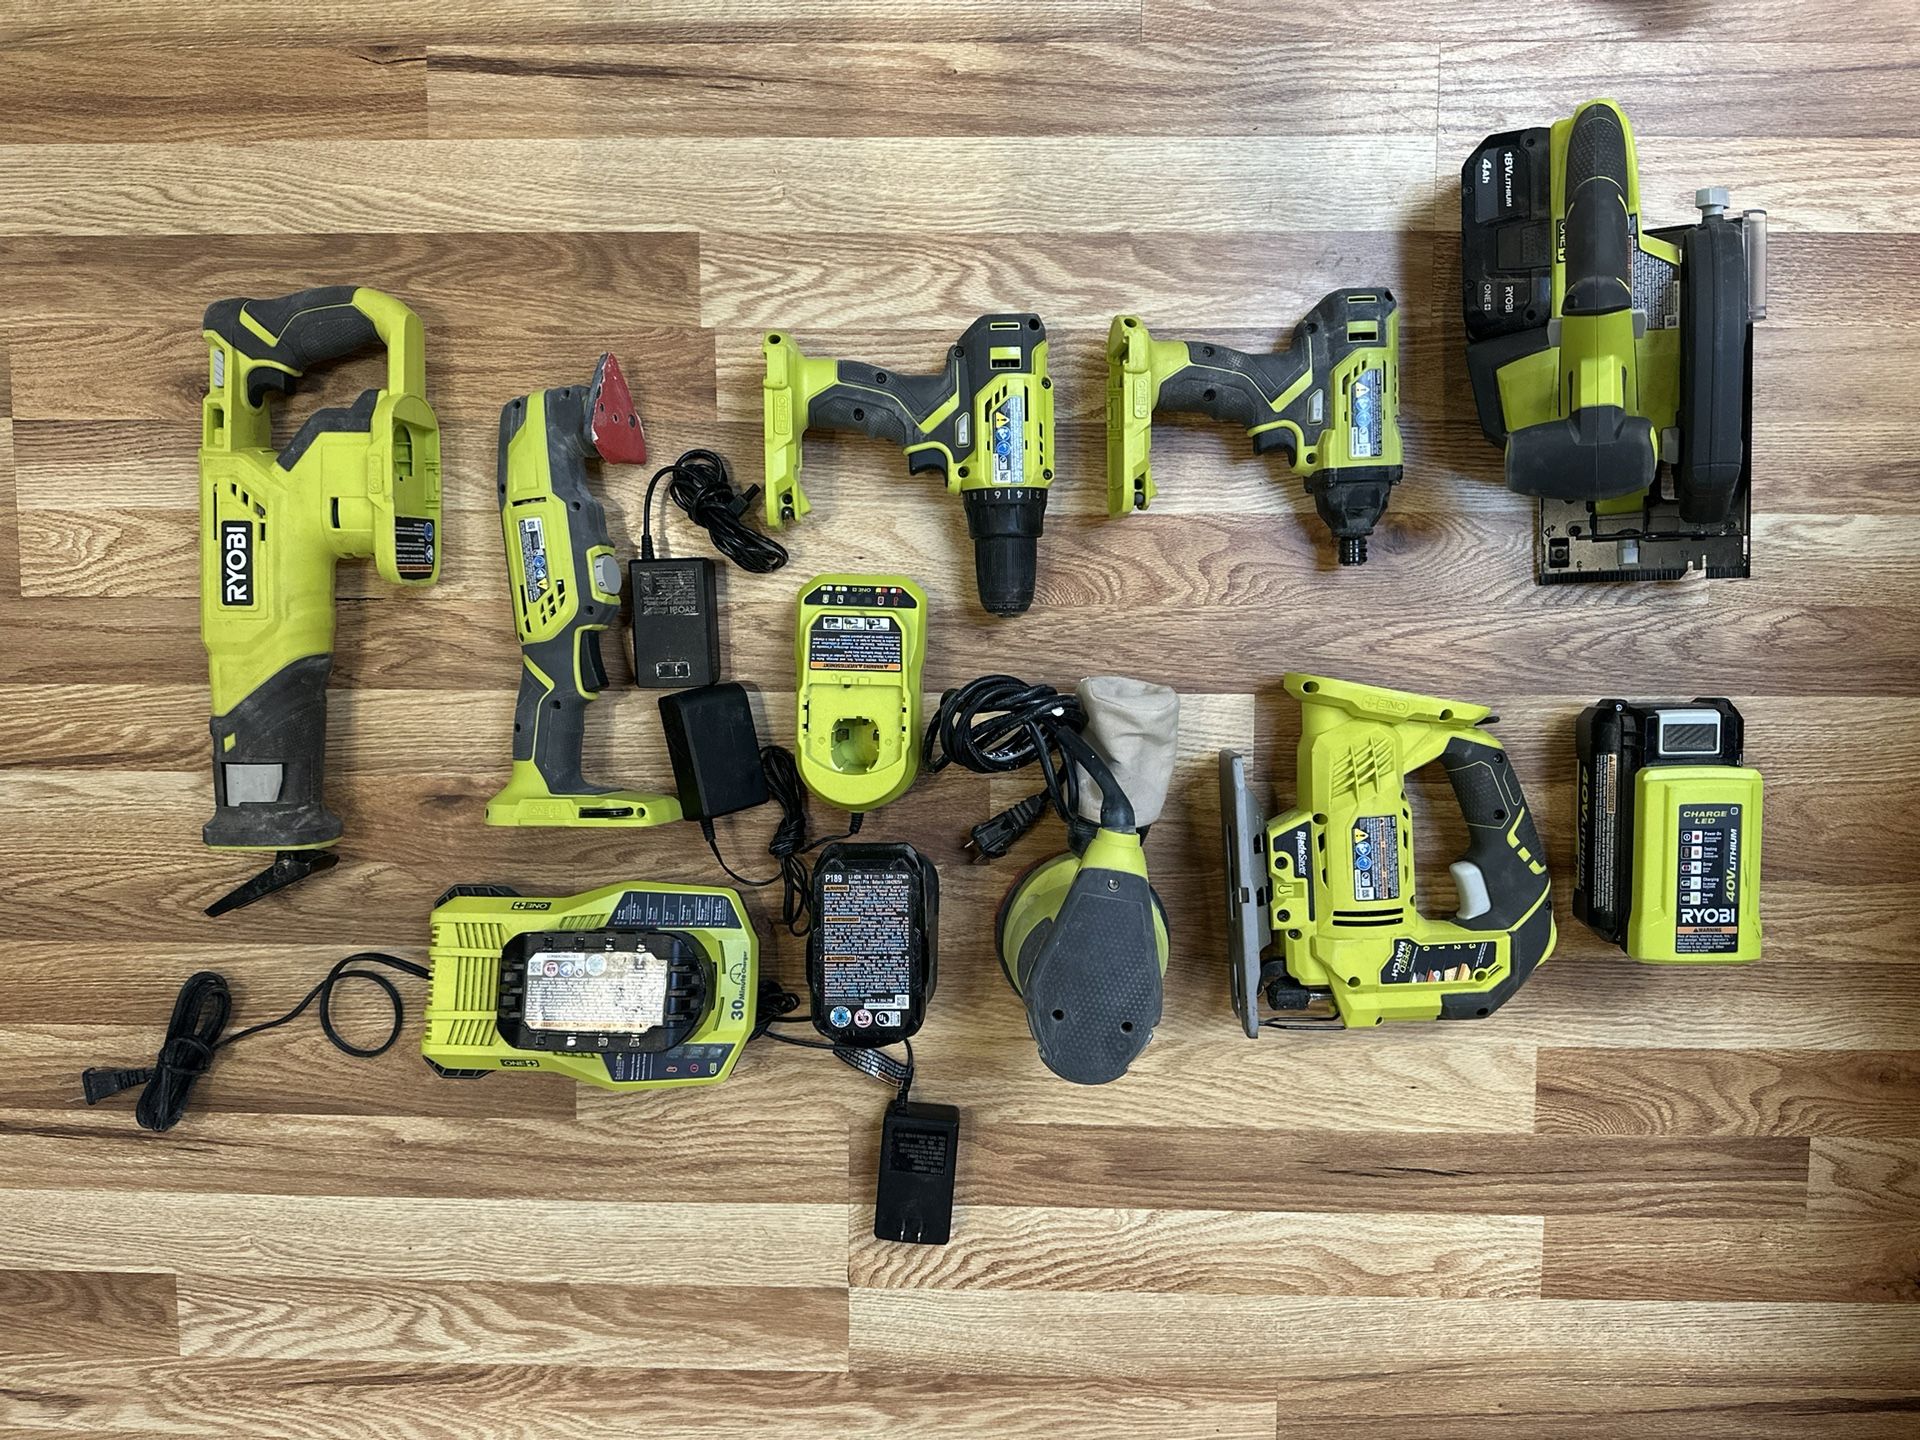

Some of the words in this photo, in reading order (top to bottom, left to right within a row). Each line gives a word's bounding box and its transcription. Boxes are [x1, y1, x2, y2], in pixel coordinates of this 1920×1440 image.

[1482, 158, 1492, 184] 4Ah
[1504, 285, 1513, 313] RYOBI
[1016, 490, 1023, 499] 4
[226, 526, 247, 602] RYOBI
[1683, 810, 1728, 818] CHARGE
[825, 874, 843, 883] P189
[1680, 908, 1736, 924] RYOBI
[1391, 941, 1406, 978] MATCH
[1400, 943, 1412, 974] SPEED
[731, 999, 744, 1020] 30
